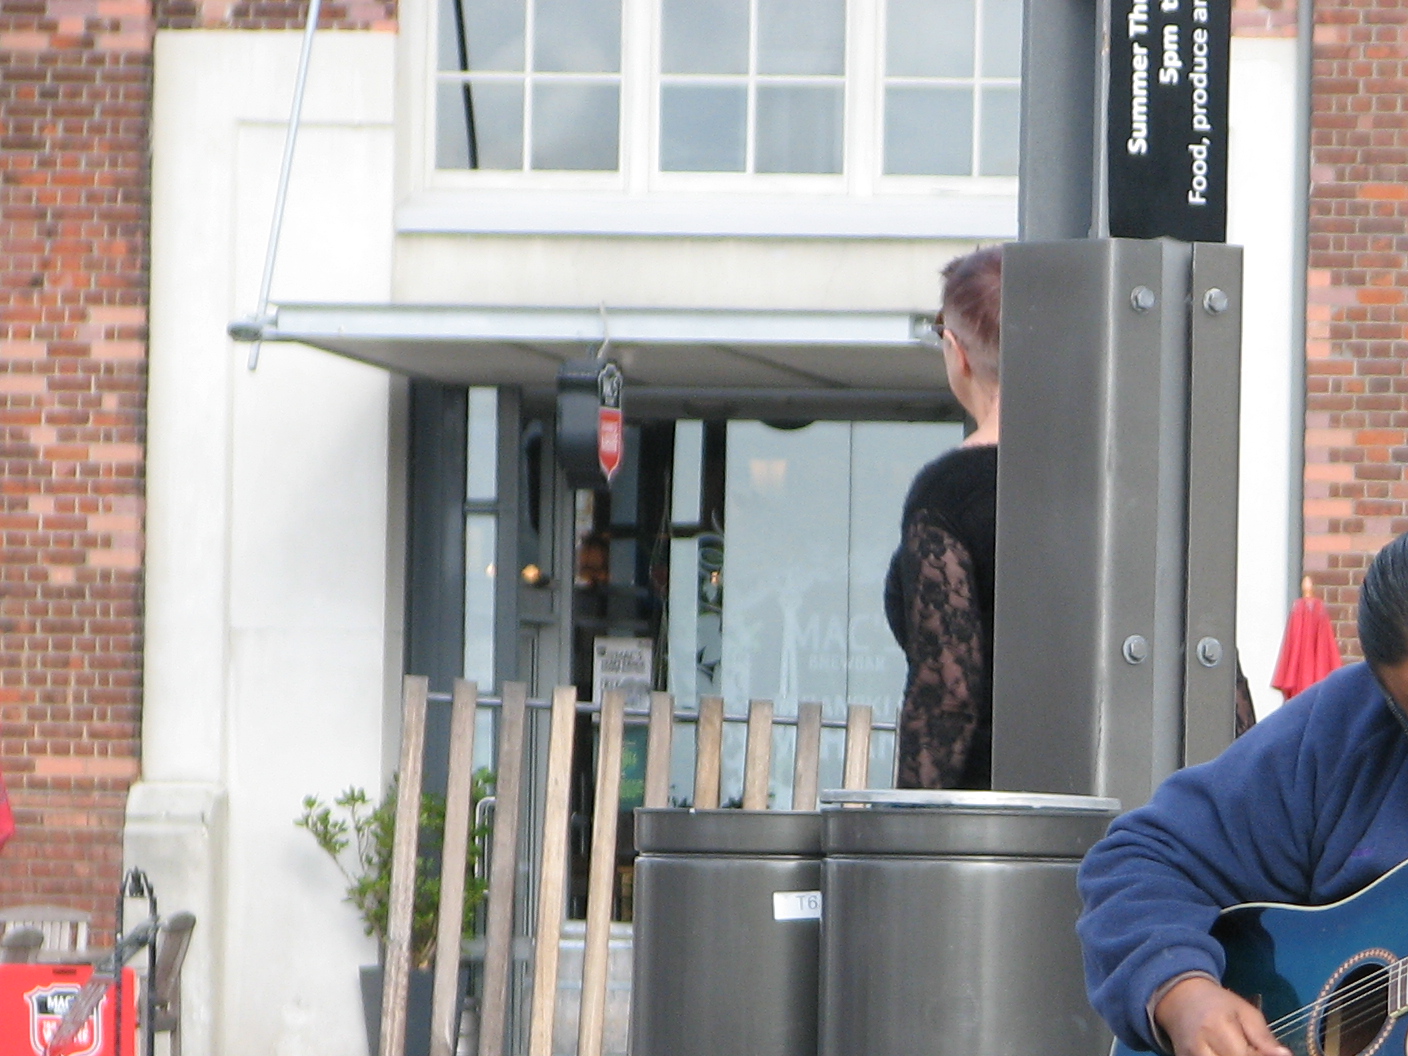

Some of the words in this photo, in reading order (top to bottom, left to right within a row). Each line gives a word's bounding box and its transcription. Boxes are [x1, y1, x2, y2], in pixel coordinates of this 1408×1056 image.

[1128, 0, 1149, 38] Th
[1159, 24, 1182, 85] 5pm
[1188, 27, 1212, 131] produce
[1128, 43, 1149, 155] Summer
[1188, 137, 1210, 205] Food,
